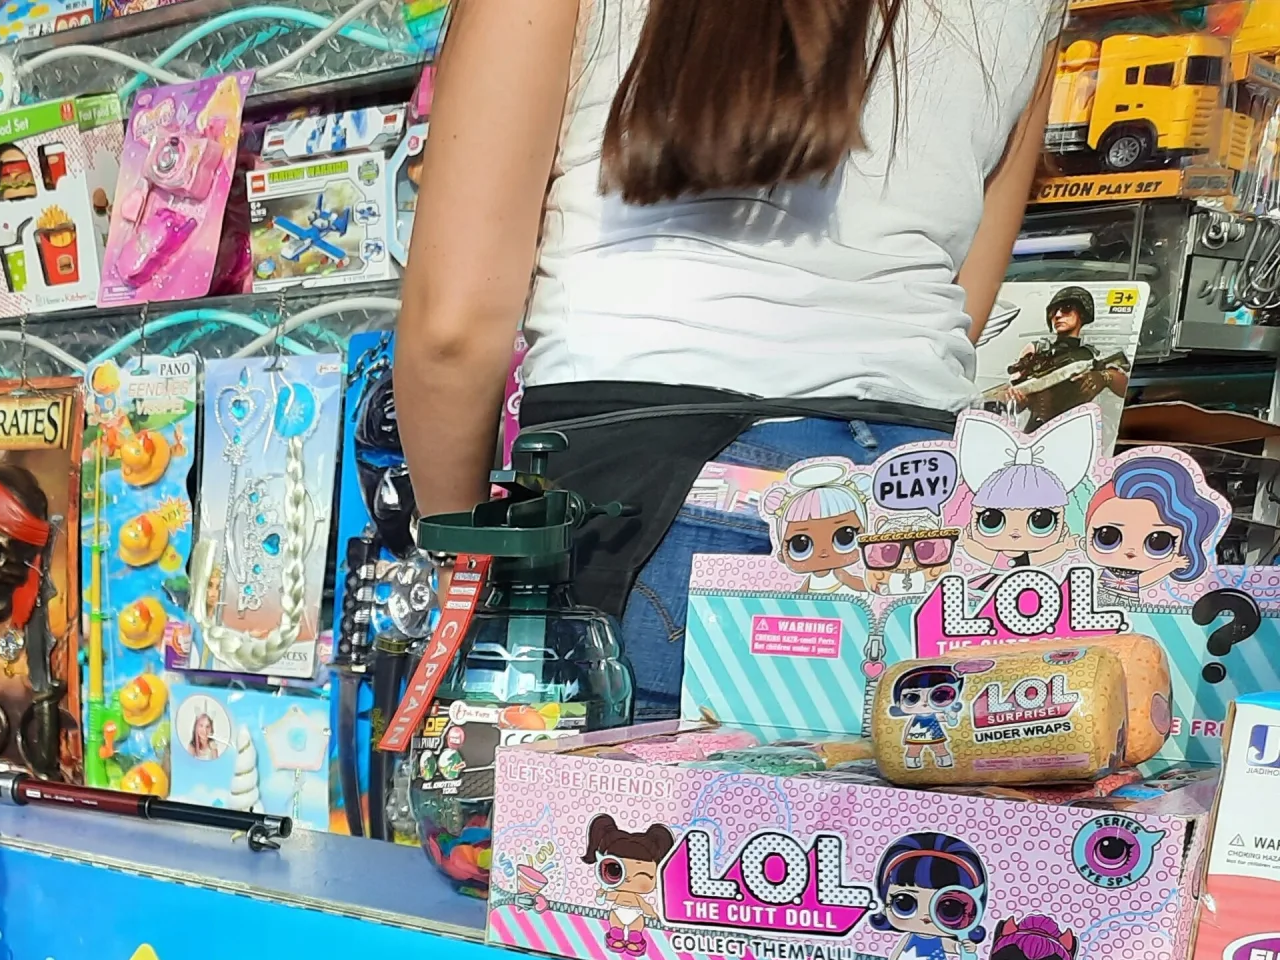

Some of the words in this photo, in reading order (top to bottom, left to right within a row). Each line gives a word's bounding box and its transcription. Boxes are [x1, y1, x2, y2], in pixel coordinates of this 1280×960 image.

[12, 117, 30, 133] Set
[1040, 182, 1093, 198] CTION
[1096, 183, 1133, 196] PLAY
[1135, 181, 1163, 194] SET
[1113, 292, 1134, 304] 3+
[159, 362, 190, 376] PANO
[889, 458, 940, 479] LET'S
[878, 475, 950, 501] PLAY!
[766, 644, 791, 652] children
[386, 621, 458, 745] CAPTAIN
[987, 707, 1061, 725] SURPRISE!
[421, 737, 440, 748] PUMP
[975, 729, 1021, 744] UNDER
[1023, 721, 1072, 738] WRAPS
[508, 763, 554, 787] LET'S
[560, 769, 583, 790] BE
[588, 772, 673, 799] FRIENDS!
[1094, 815, 1141, 835] SERIES
[1227, 850, 1261, 861] CHOKING
[1079, 864, 1103, 885] EYE
[1105, 872, 1134, 887] SPY
[683, 901, 719, 920] THE
[727, 905, 778, 925] CUTT
[785, 909, 837, 930] DOLL
[672, 935, 746, 957] COLLECT
[751, 941, 806, 960] THEM
